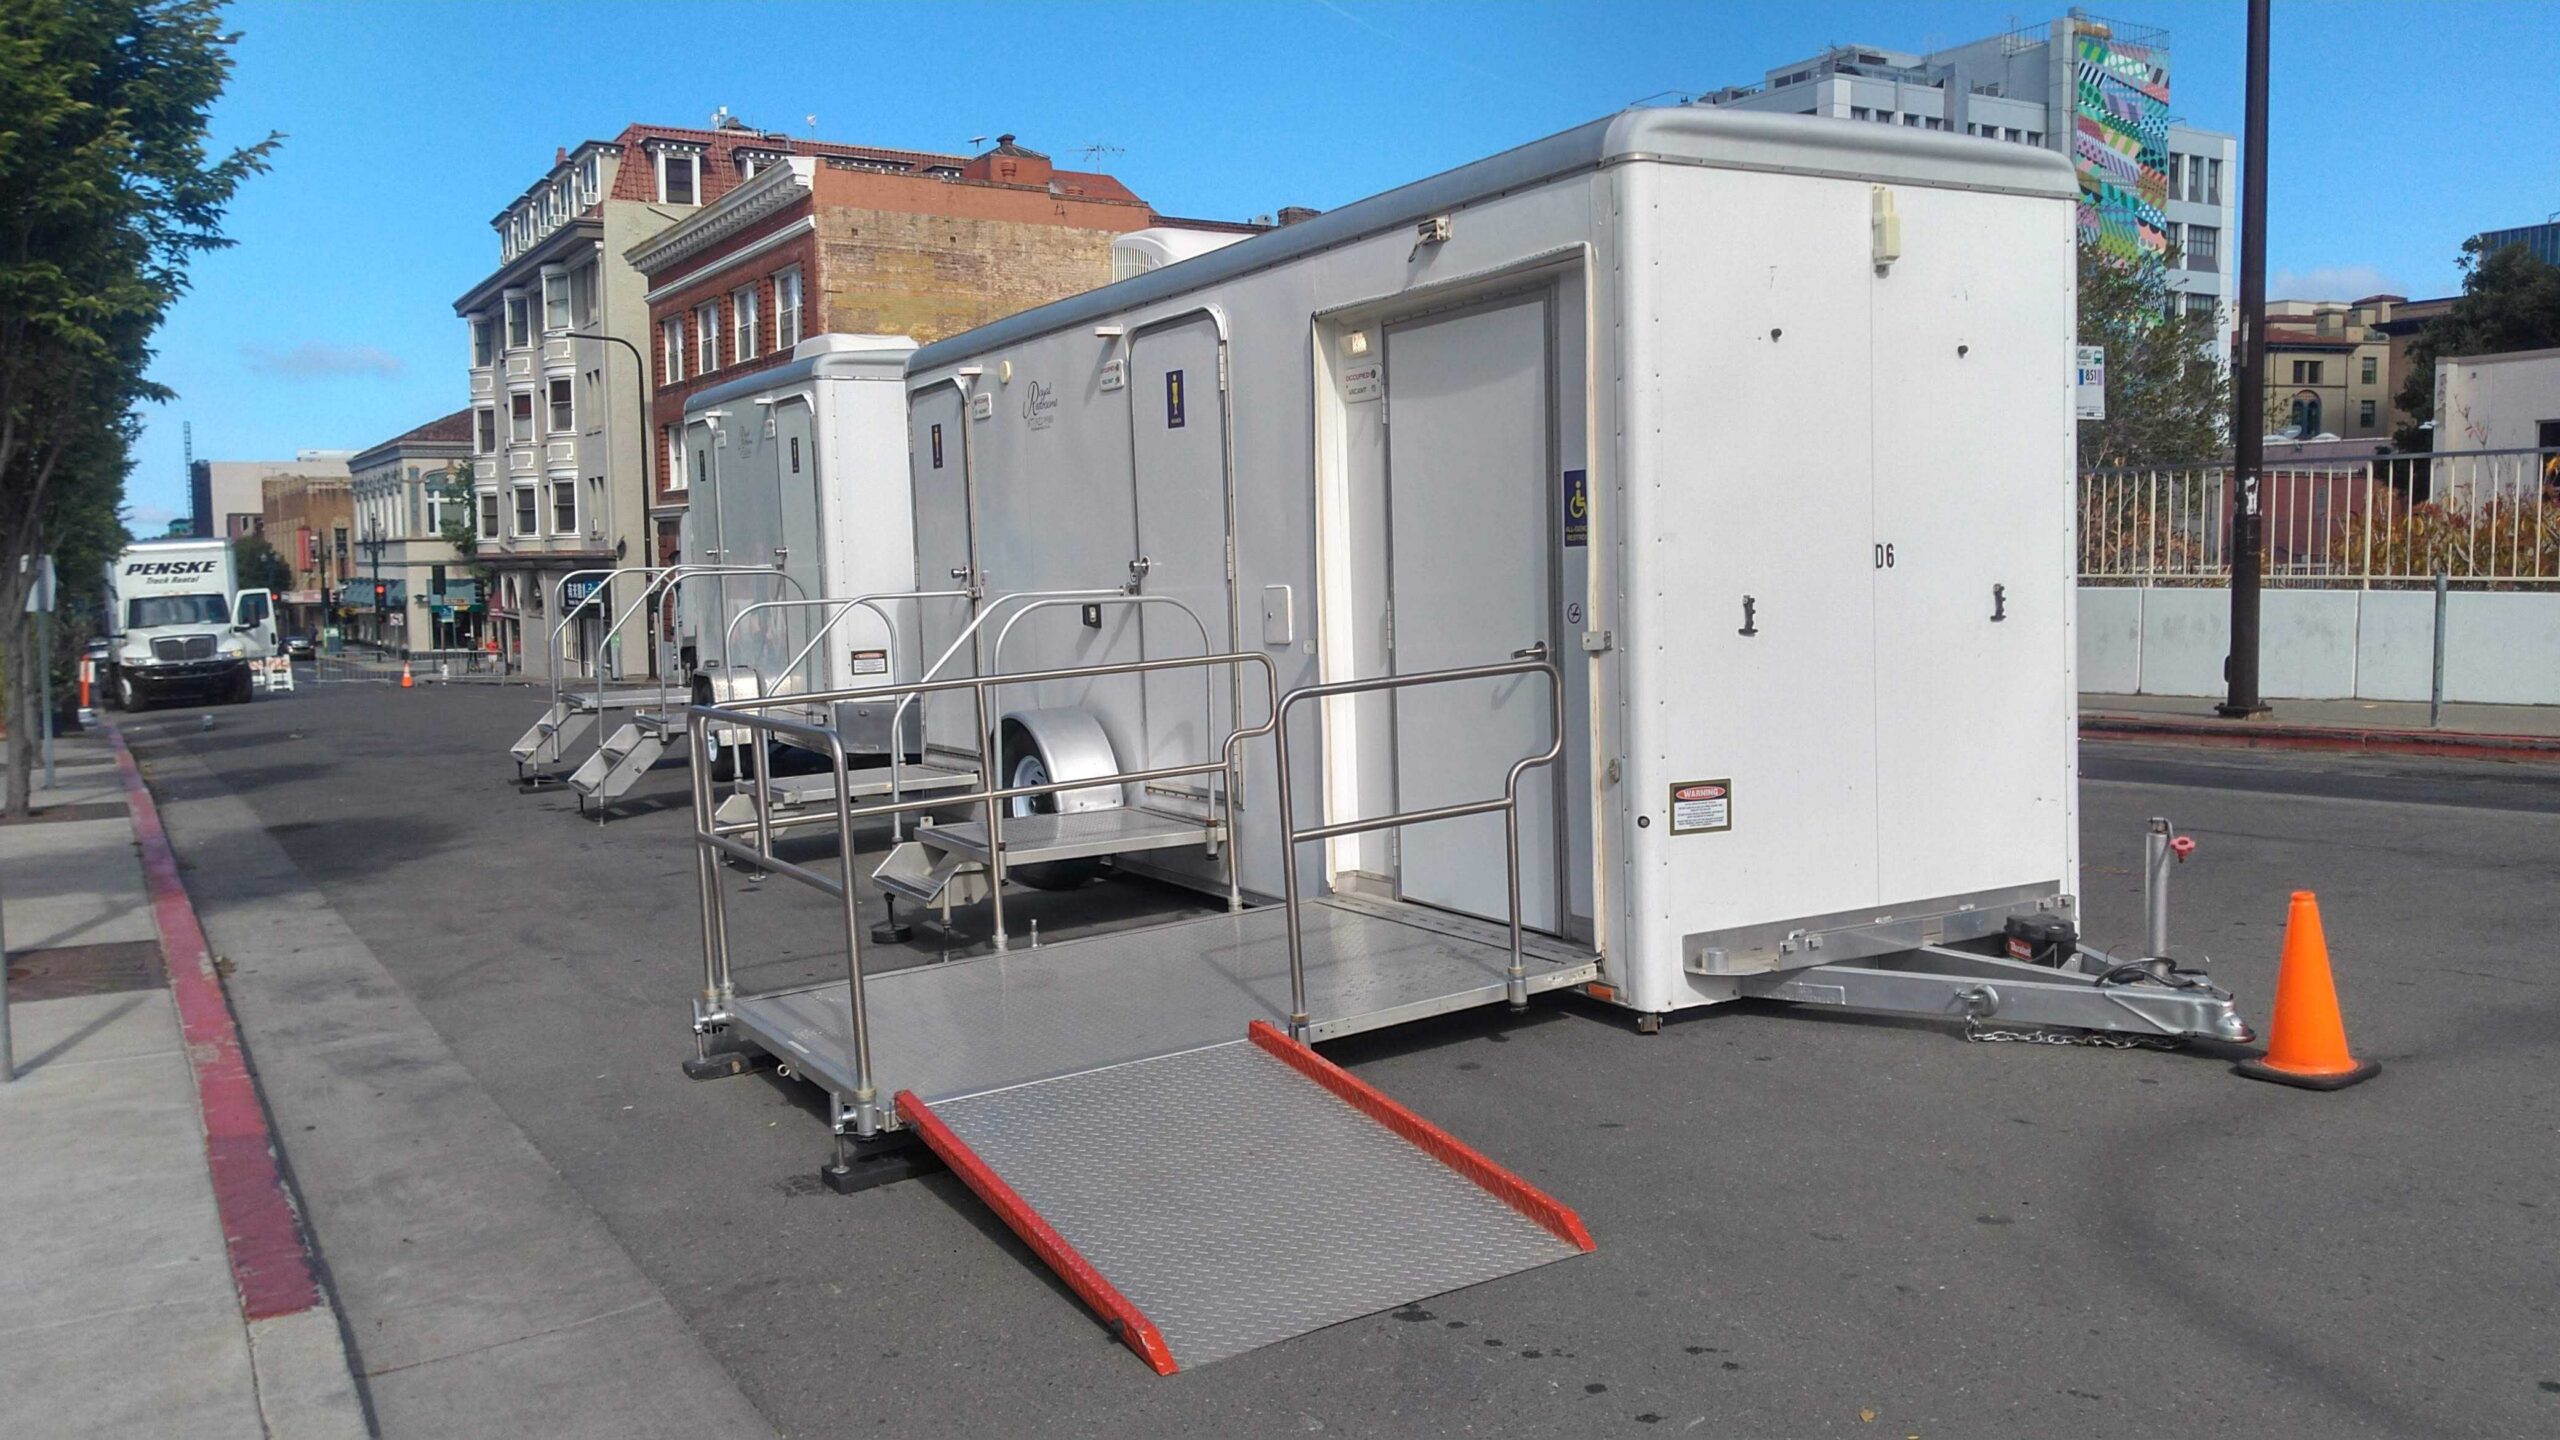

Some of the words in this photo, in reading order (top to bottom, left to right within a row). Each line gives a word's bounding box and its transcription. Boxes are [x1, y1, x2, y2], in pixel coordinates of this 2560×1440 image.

[1345, 371, 1370, 382] OCCUPIED
[2085, 370, 2097, 381] 851
[1348, 386, 1367, 395] VACANT
[1875, 543, 1894, 569] D6
[125, 561, 217, 576] PENSKE
[146, 577, 169, 585] Truck
[171, 576, 199, 584] Rental
[1683, 788, 1718, 799] WARNING
